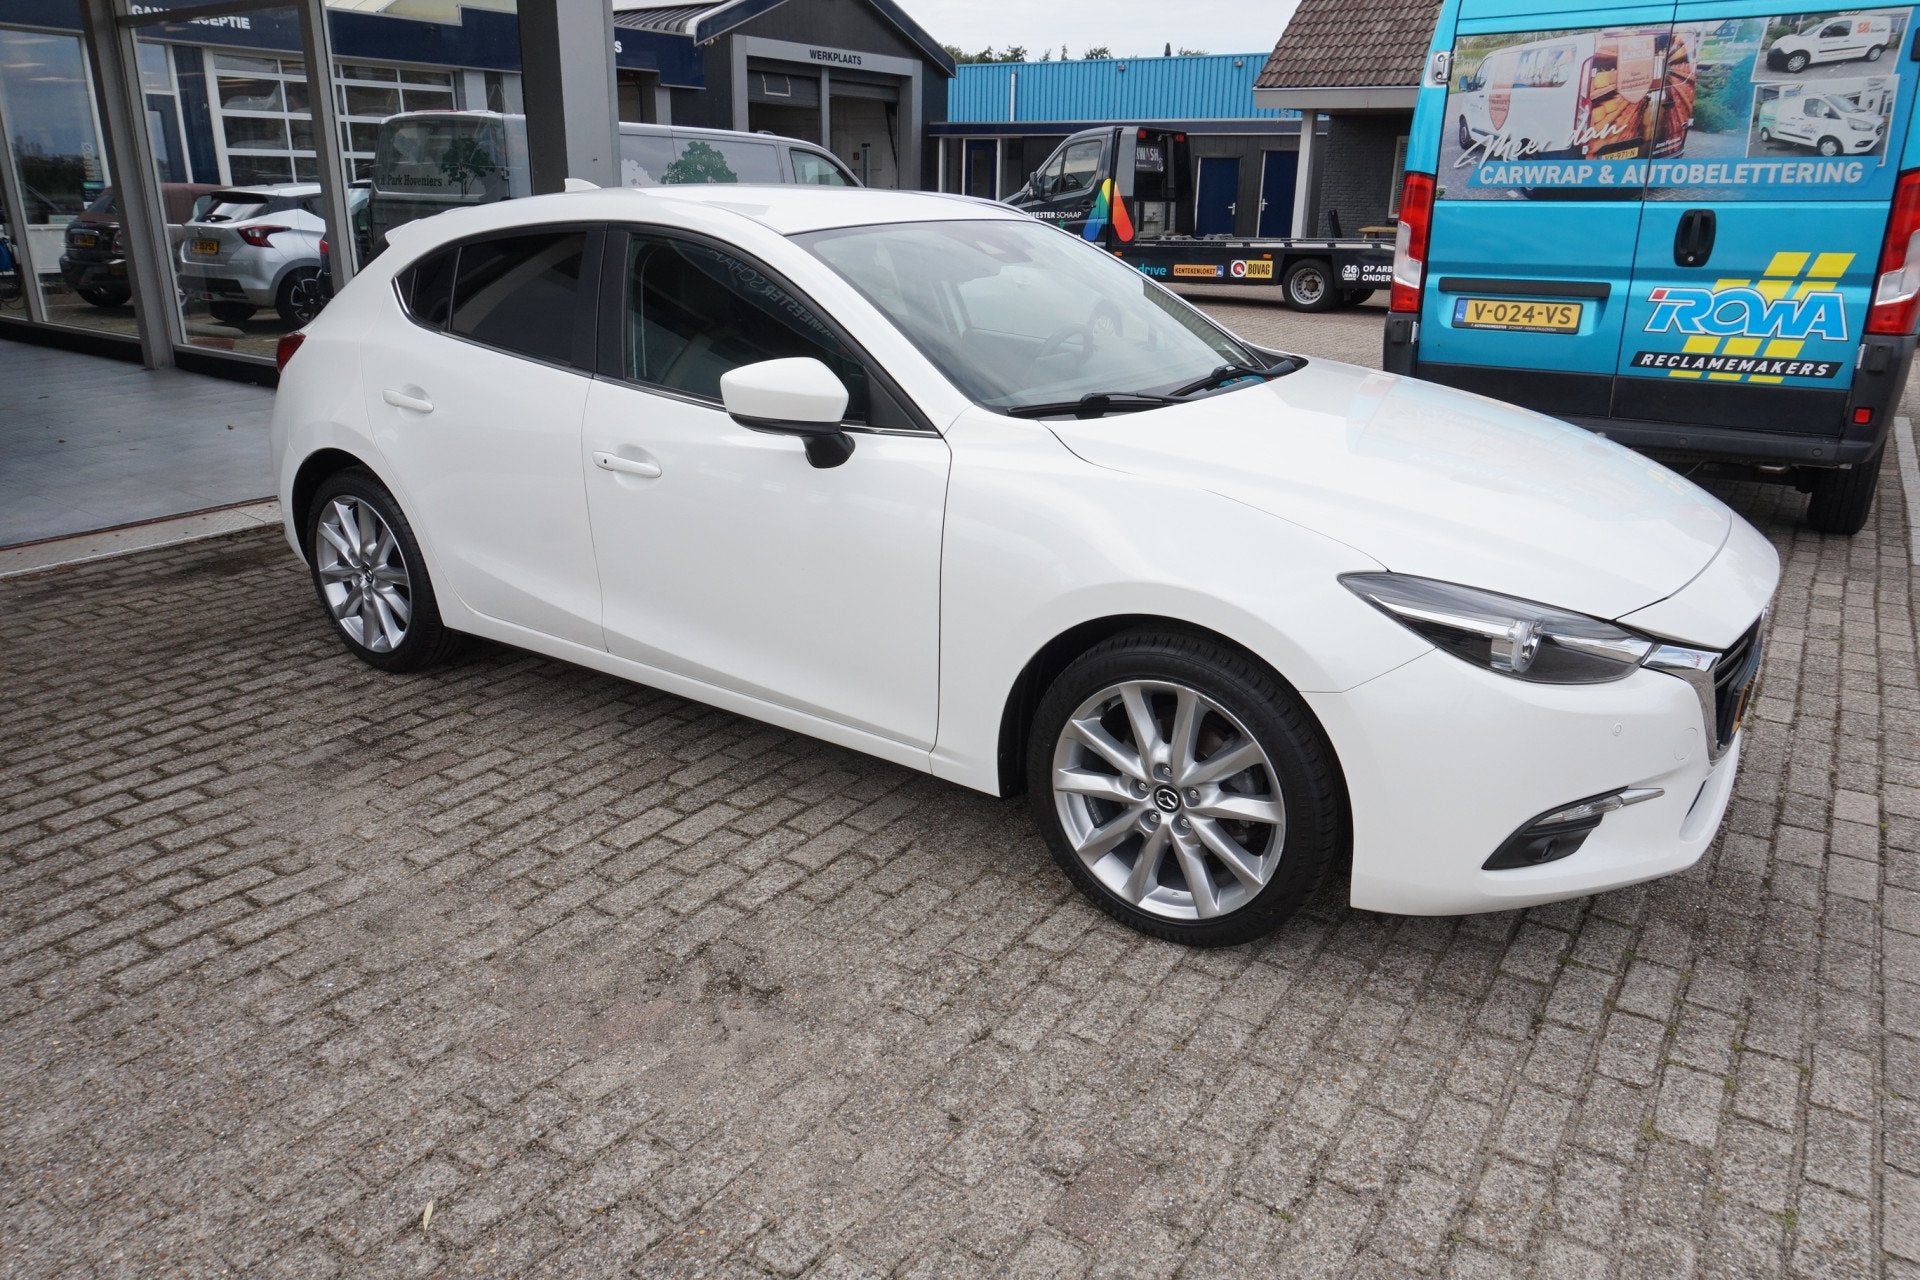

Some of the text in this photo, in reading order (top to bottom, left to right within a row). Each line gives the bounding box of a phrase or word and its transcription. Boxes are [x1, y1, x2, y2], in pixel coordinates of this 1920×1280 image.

[809, 49, 862, 66] WERKPLAATS
[1568, 116, 1628, 146] dan
[387, 175, 403, 186] Park
[404, 174, 442, 187] Hoveniers
[1479, 162, 1864, 185] CARWRAP & AUTOBELETTERING
[1056, 211, 1082, 219] SCHAAP
[1138, 263, 1167, 276] drive
[1174, 266, 1216, 276] KENTEKENLOKET
[1247, 263, 1271, 275] BOVAG
[1344, 264, 1357, 273] 36
[1474, 303, 1572, 325] V-024-VS
[1643, 286, 1849, 341] ROWA
[1640, 353, 1830, 377] RECLAMEMAKERS
